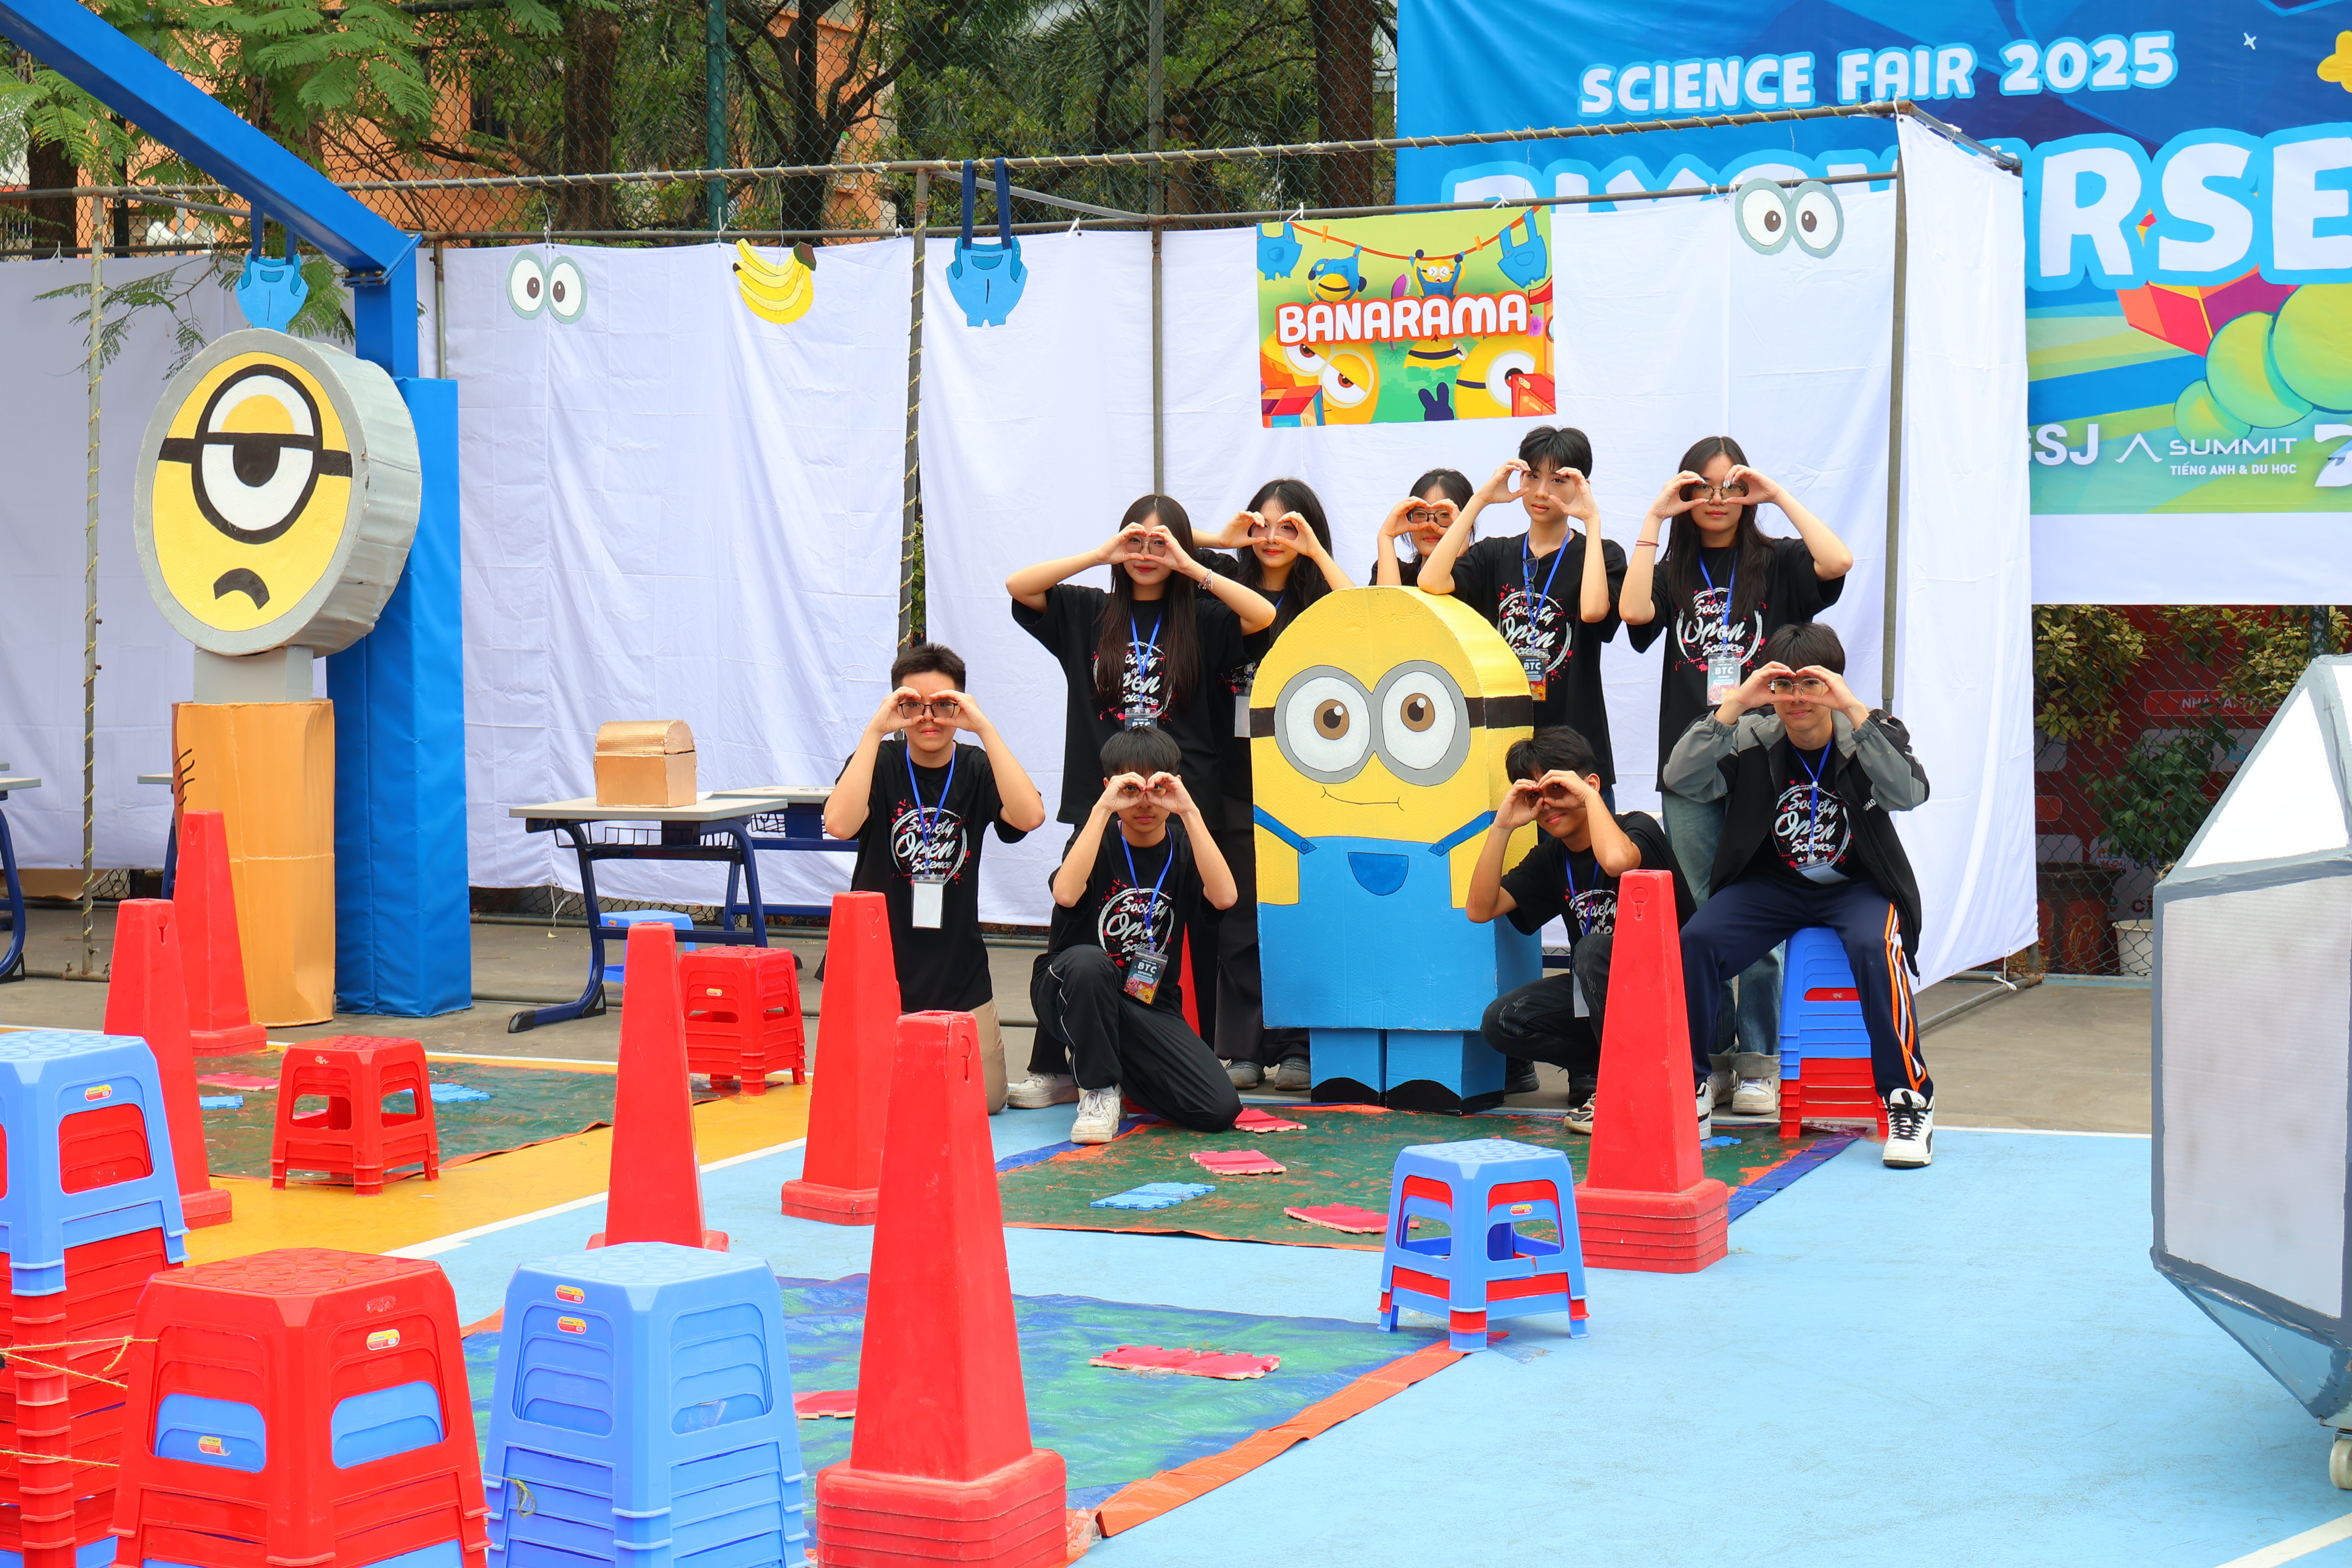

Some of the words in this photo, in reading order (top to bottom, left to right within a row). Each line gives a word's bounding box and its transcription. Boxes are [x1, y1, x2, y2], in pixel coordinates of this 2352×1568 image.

[1581, 56, 1811, 113] SCIENCE
[1841, 47, 1973, 101] FAIR
[2004, 35, 2174, 91] 2025
[1278, 294, 1528, 345] BANARAMA
[2028, 423, 2099, 466] SJ
[2169, 438, 2297, 456] SUMMIT
[2170, 461, 2207, 475] TIẾNG
[2209, 465, 2236, 475] ANH
[2239, 465, 2248, 475] &
[2251, 464, 2268, 474] DU
[2271, 464, 2297, 476] HỌC
[1524, 662, 1541, 670] BTC
[1715, 666, 1733, 675] BTC
[1775, 811, 1837, 842] Open
[895, 831, 956, 861] Open
[1597, 915, 1606, 928] of
[1137, 962, 1157, 974] BTC
